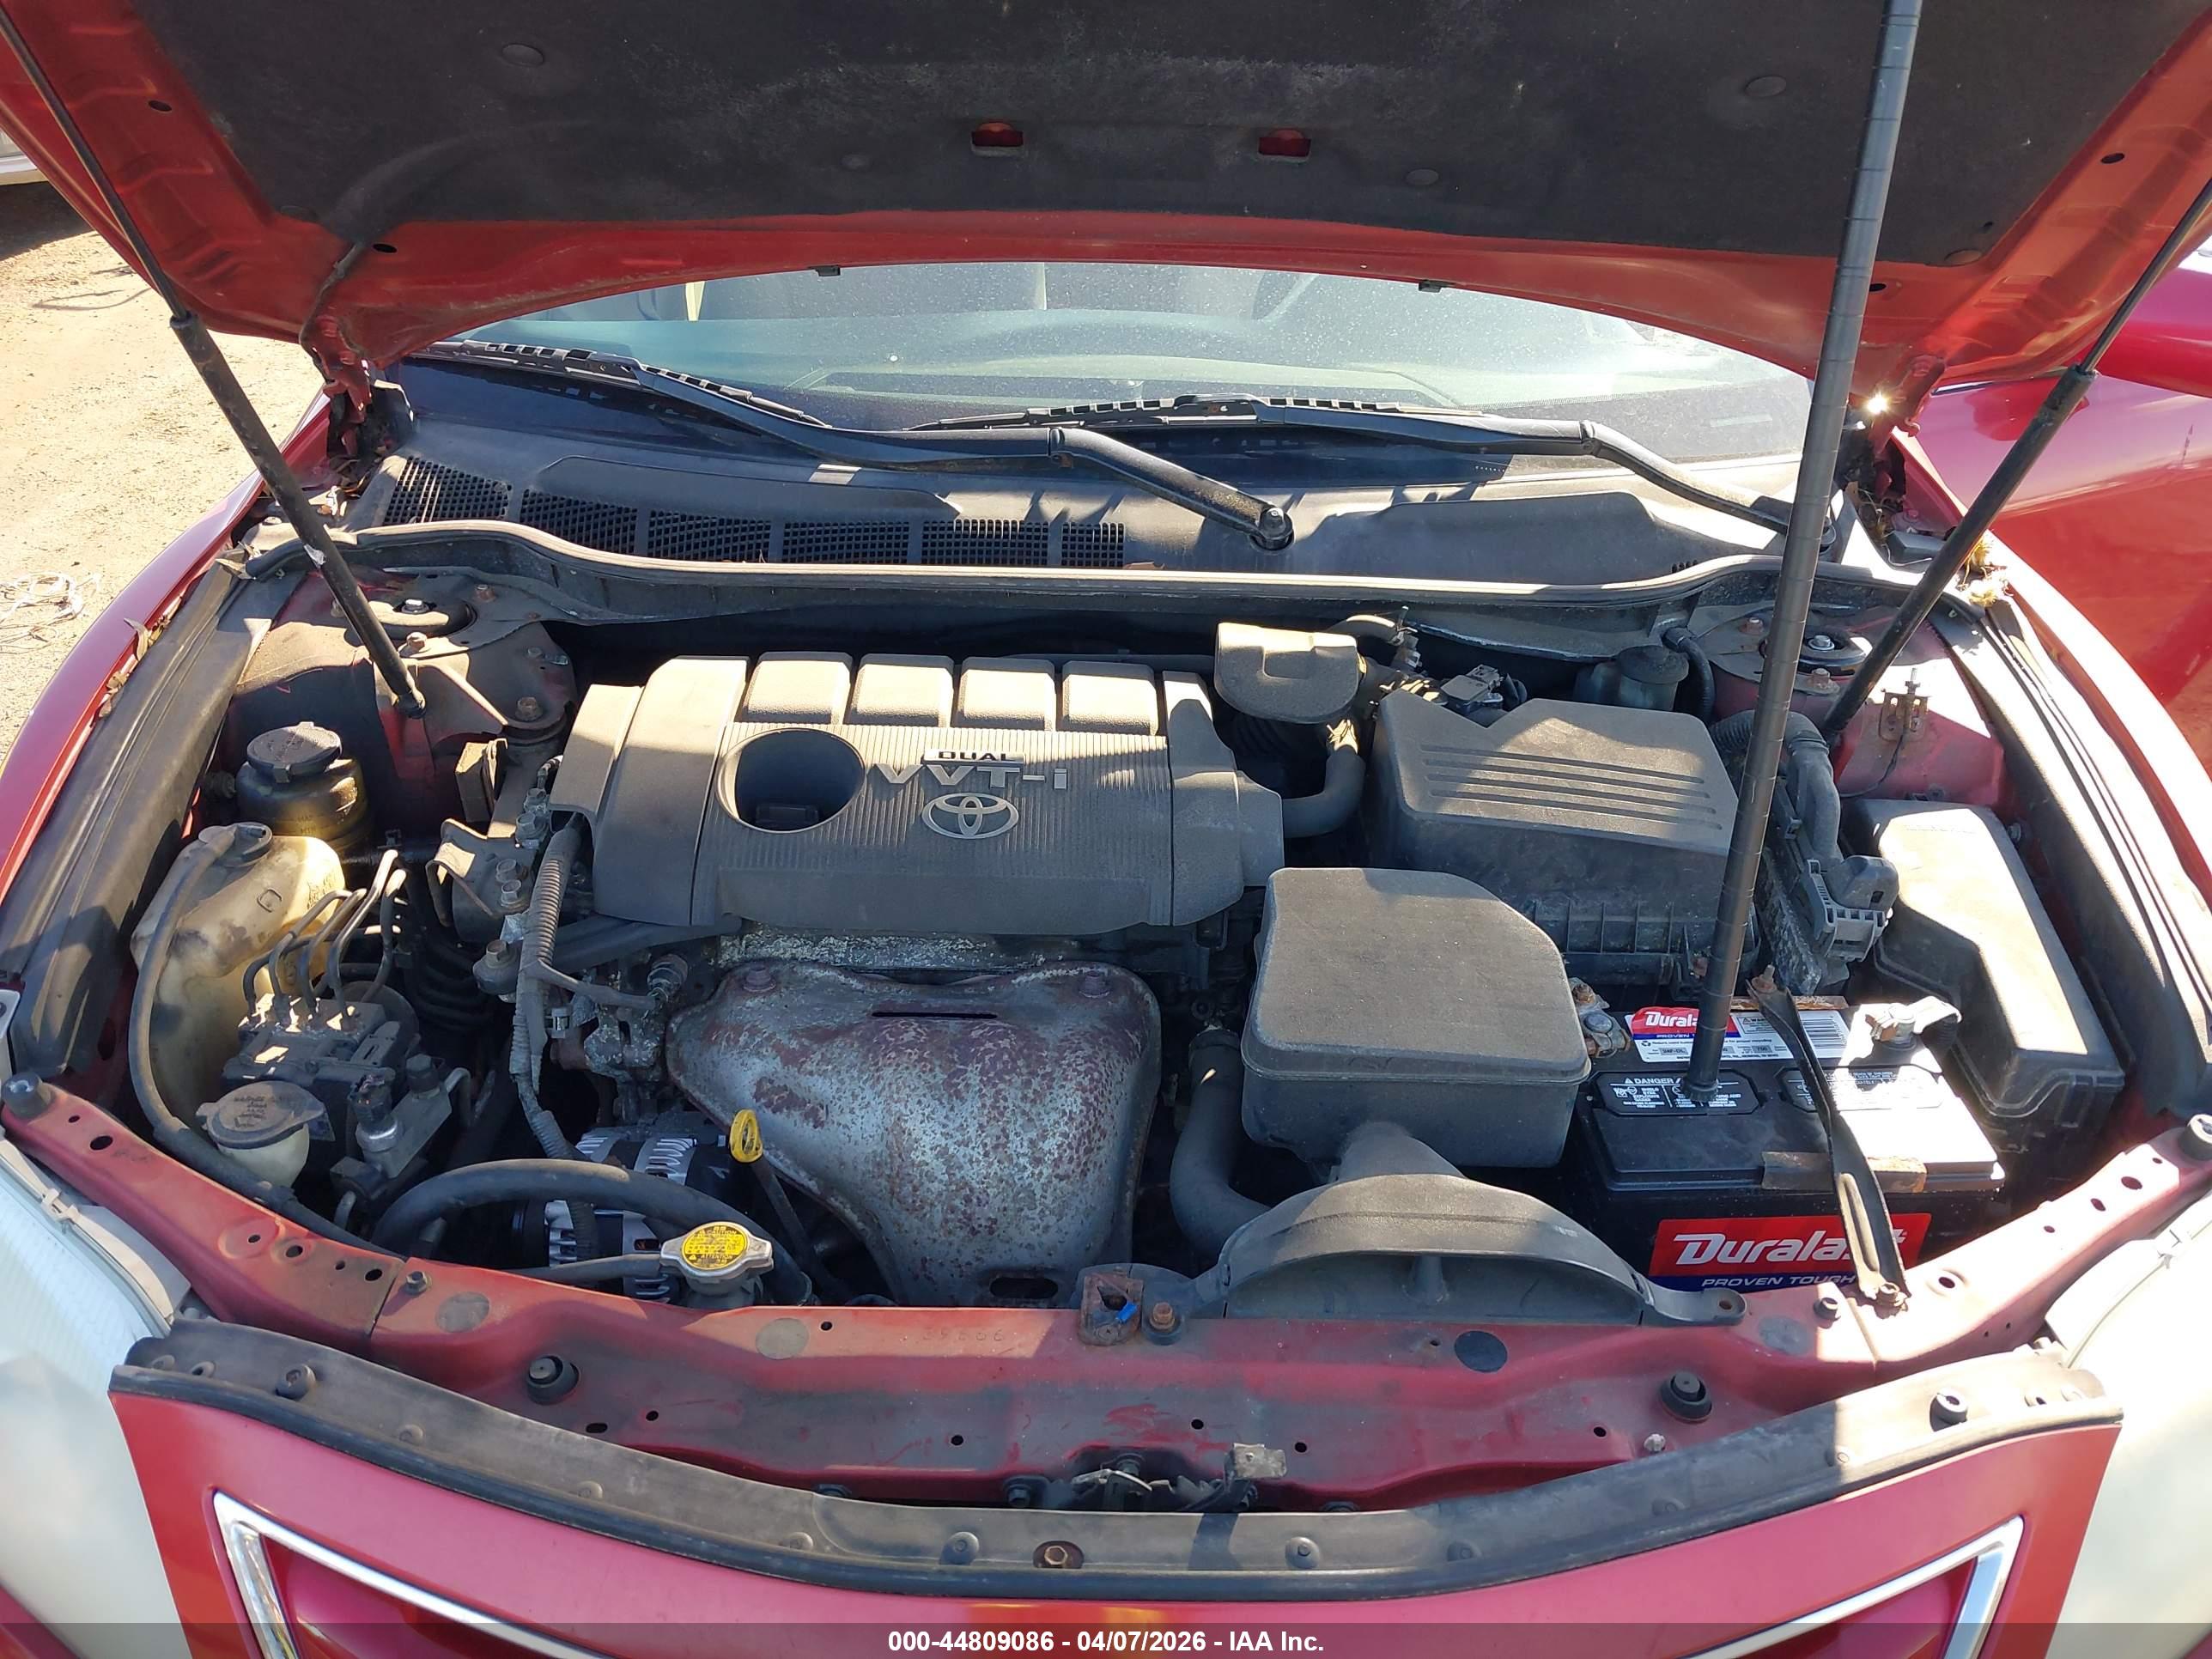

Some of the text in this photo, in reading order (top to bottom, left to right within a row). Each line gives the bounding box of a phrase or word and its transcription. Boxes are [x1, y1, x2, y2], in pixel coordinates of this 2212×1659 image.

[939, 751, 1012, 761] DUAL
[874, 763, 1068, 790] VVT-i
[1644, 1011, 1698, 1027] Dural
[1674, 1229, 1906, 1266] Durala
[1701, 1275, 1856, 1287] PROVEN TOUGH
